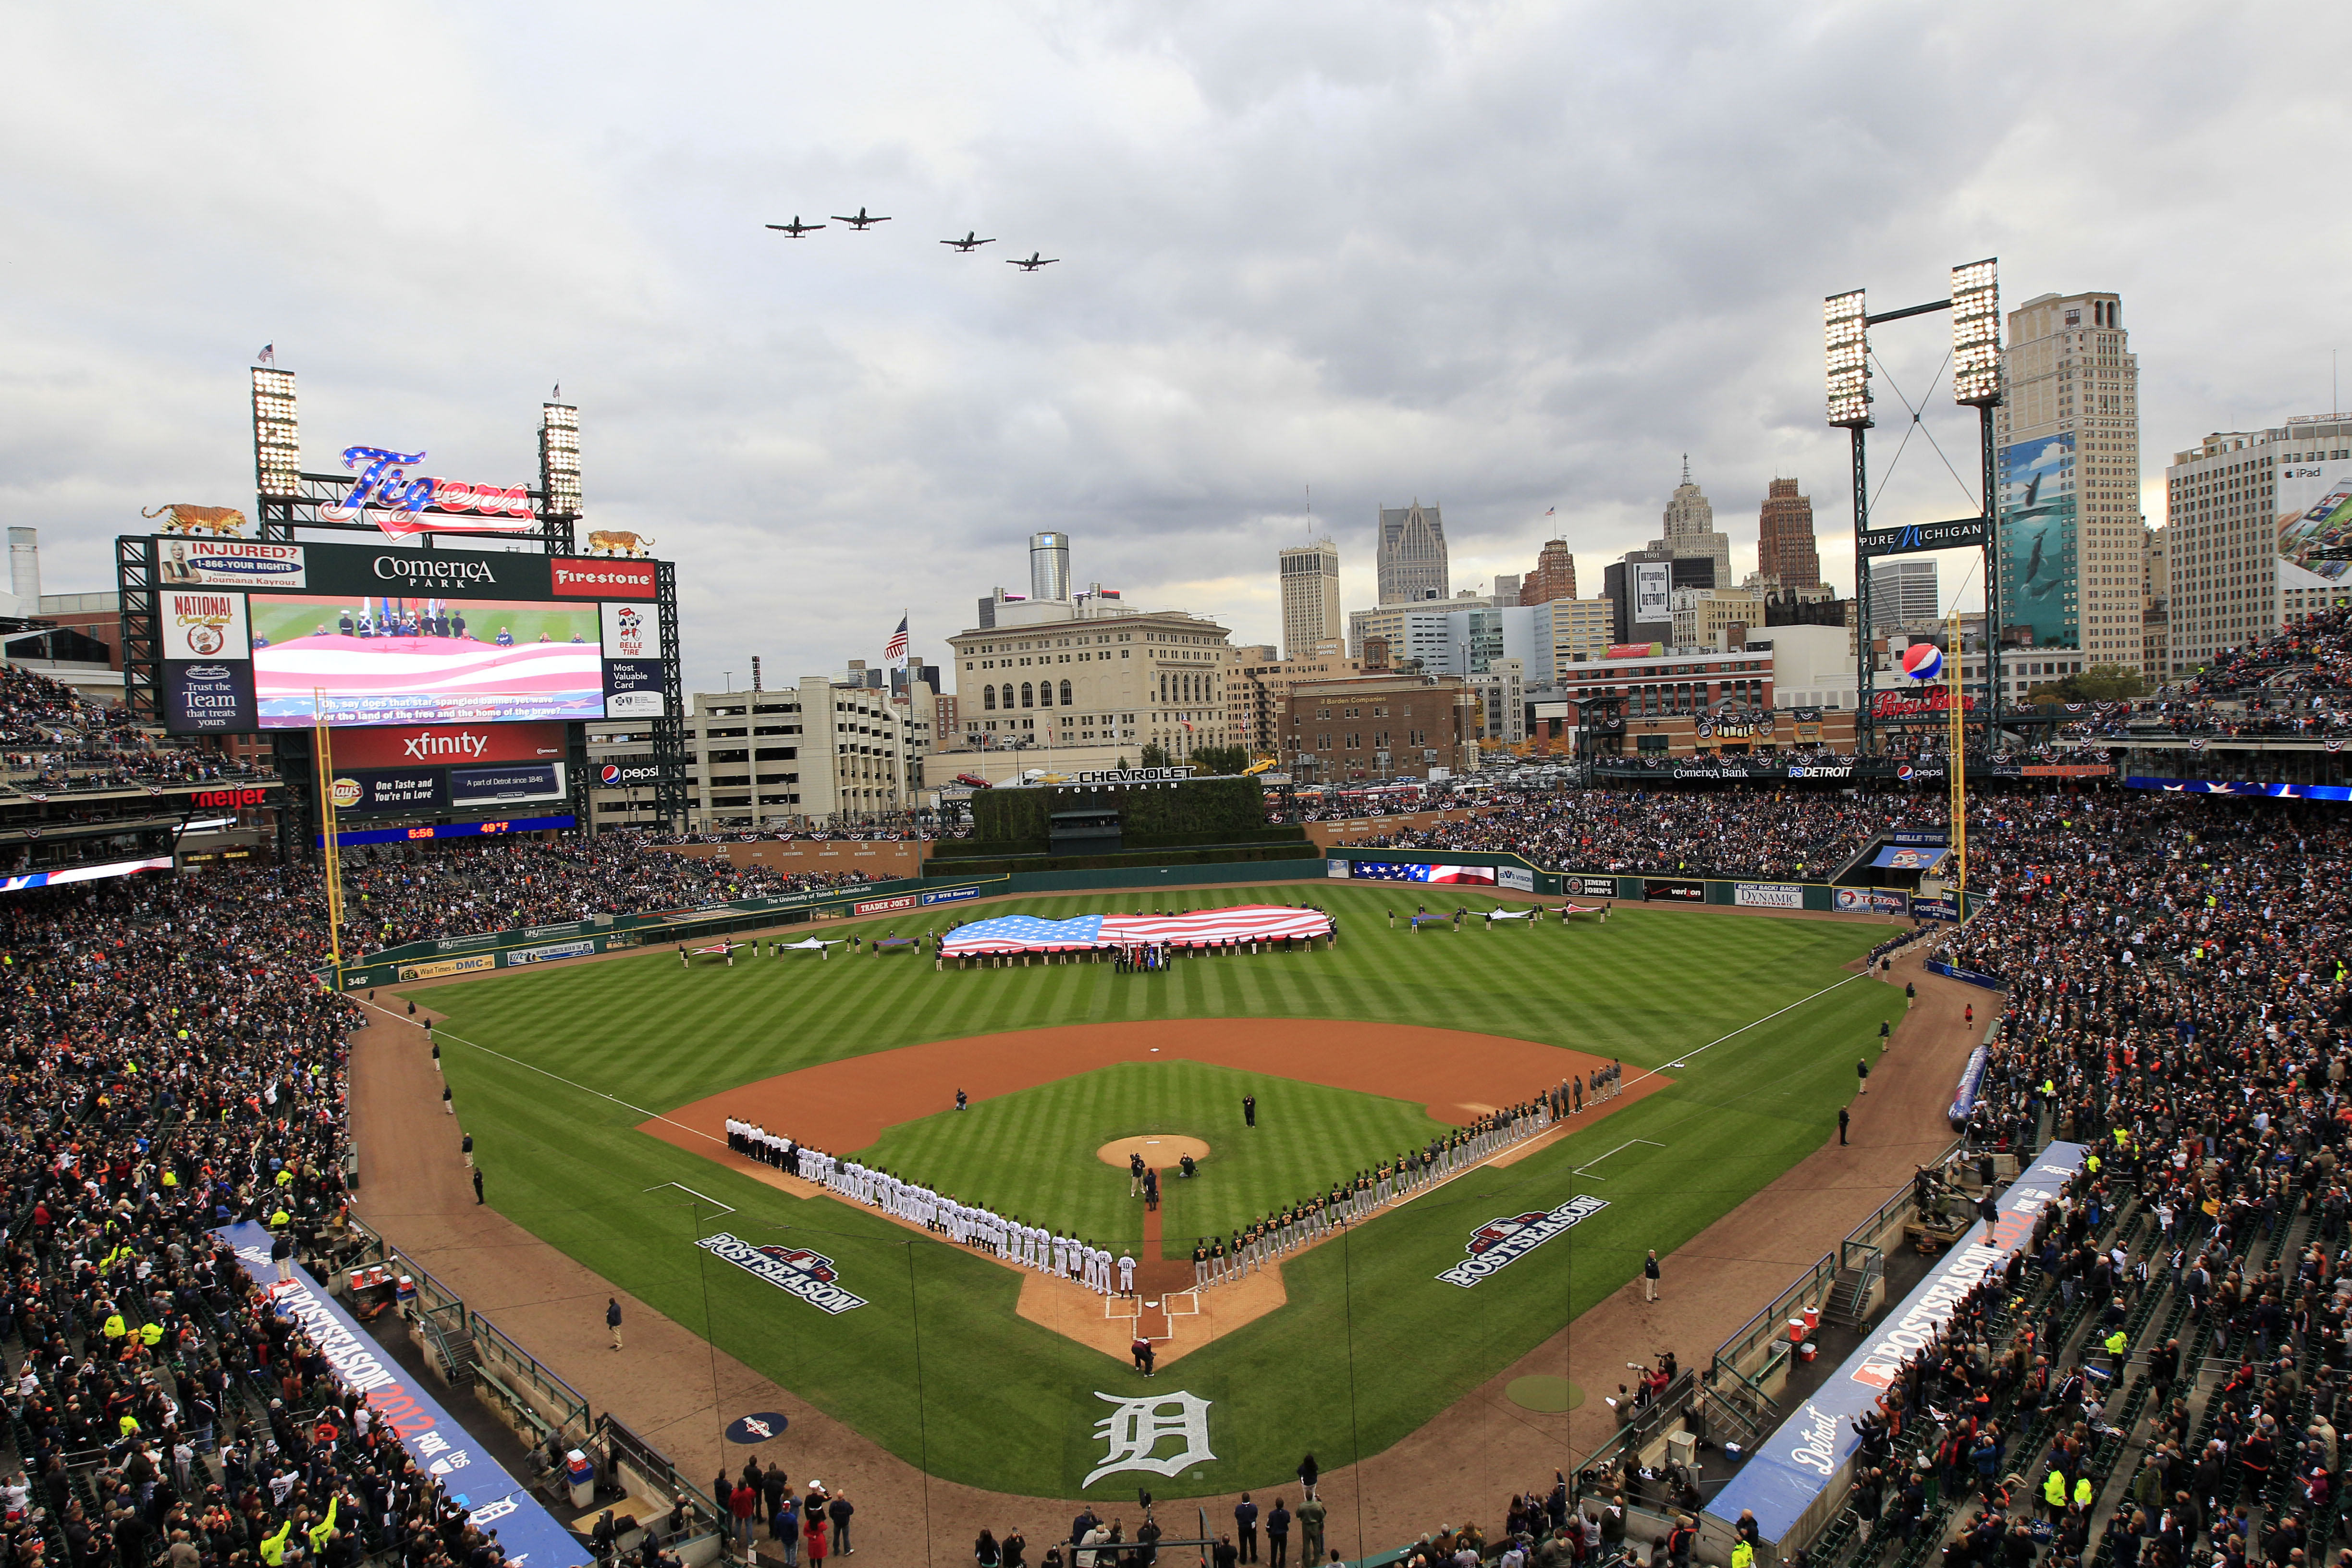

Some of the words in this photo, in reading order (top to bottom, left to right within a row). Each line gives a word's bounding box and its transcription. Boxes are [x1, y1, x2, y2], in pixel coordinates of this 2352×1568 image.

[2296, 467, 2320, 478] iPad
[318, 445, 535, 529] Tigers
[1861, 534, 1895, 547] PURE
[1888, 524, 1981, 554] MICHIGAN
[193, 543, 297, 559] INJURED?
[196, 560, 255, 570] 1-866-YOUR
[257, 562, 292, 571] RIGHTS
[206, 576, 253, 584] Joumana
[257, 578, 296, 586] Kayrouz
[409, 577, 466, 588] PARK
[555, 569, 650, 585] Firestone
[1641, 572, 1665, 581] OUTSOURCE
[1651, 583, 1656, 591] TO
[1642, 593, 1665, 606] DETROIT
[174, 596, 233, 616] NATIONAL
[613, 663, 635, 672] Most
[186, 683, 213, 691] Trust
[215, 682, 231, 691] the
[614, 681, 634, 689] Card
[183, 691, 237, 708] Team
[321, 699, 339, 710] Oh,
[342, 700, 360, 709] say
[362, 698, 387, 708] does
[389, 698, 411, 707] that
[413, 696, 479, 707] star-spangled
[515, 697, 528, 706] yet
[1871, 691, 1918, 717] PEPSI
[186, 710, 207, 718] that
[209, 709, 236, 717] treats
[338, 712, 355, 721] the
[358, 711, 381, 720] land
[383, 710, 394, 719] of
[396, 710, 413, 719] the
[414, 710, 435, 718] free
[437, 709, 456, 718] and
[457, 709, 474, 717] the
[476, 708, 502, 717] home
[503, 707, 514, 716] of
[515, 707, 530, 715] the
[532, 707, 562, 715] brave?
[198, 718, 226, 728] yours
[1717, 723, 1754, 738] JUNGLE
[403, 732, 488, 760] xfinity
[623, 765, 659, 781] pepsi
[1078, 766, 1197, 784] CHEVROLET
[1722, 768, 1749, 777] Bank
[1915, 768, 1943, 777] pepsi
[376, 781, 392, 790] One
[395, 780, 416, 789] Taste
[417, 778, 433, 788] and
[1058, 783, 1177, 794] FOUNTAIN
[374, 792, 401, 802] You're
[403, 791, 411, 800] In
[414, 790, 432, 799] Love
[408, 828, 434, 839] 5:56
[480, 822, 509, 833] 49°F
[1516, 874, 1532, 883] VISION
[779, 894, 808, 904] University
[816, 890, 834, 898] Toledo
[839, 885, 872, 895] utoledo.edu
[1671, 888, 1701, 896] verizon
[1741, 890, 1797, 903] DYNAMIC
[1942, 892, 1954, 901] 330'
[860, 901, 889, 912] TRADER
[890, 899, 910, 908] JOE'S
[1860, 895, 1902, 906] TOTAL
[696, 903, 730, 911] 313-471-BALL
[1914, 905, 1958, 916] POSTSEASON
[525, 929, 539, 938] UHY
[438, 940, 453, 949] UHY
[419, 967, 434, 975] Wait
[434, 966, 452, 974] Times
[456, 959, 492, 970] DMC.org
[348, 976, 368, 986] 345'
[404, 970, 415, 980] ER
[2012, 1198, 2041, 1214] FOX
[1444, 1196, 1601, 1286] POSTSEASON
[704, 1233, 861, 1311] POSTSEASON
[1877, 1243, 2006, 1365] POSTSEASON
[288, 1286, 397, 1393] POSTSEASON
[368, 1384, 435, 1438] 2012
[412, 1431, 451, 1458] FOX
[1081, 1390, 1218, 1490] D
[1791, 1404, 1838, 1475] Detroit
[275, 1485, 286, 1495] 27
